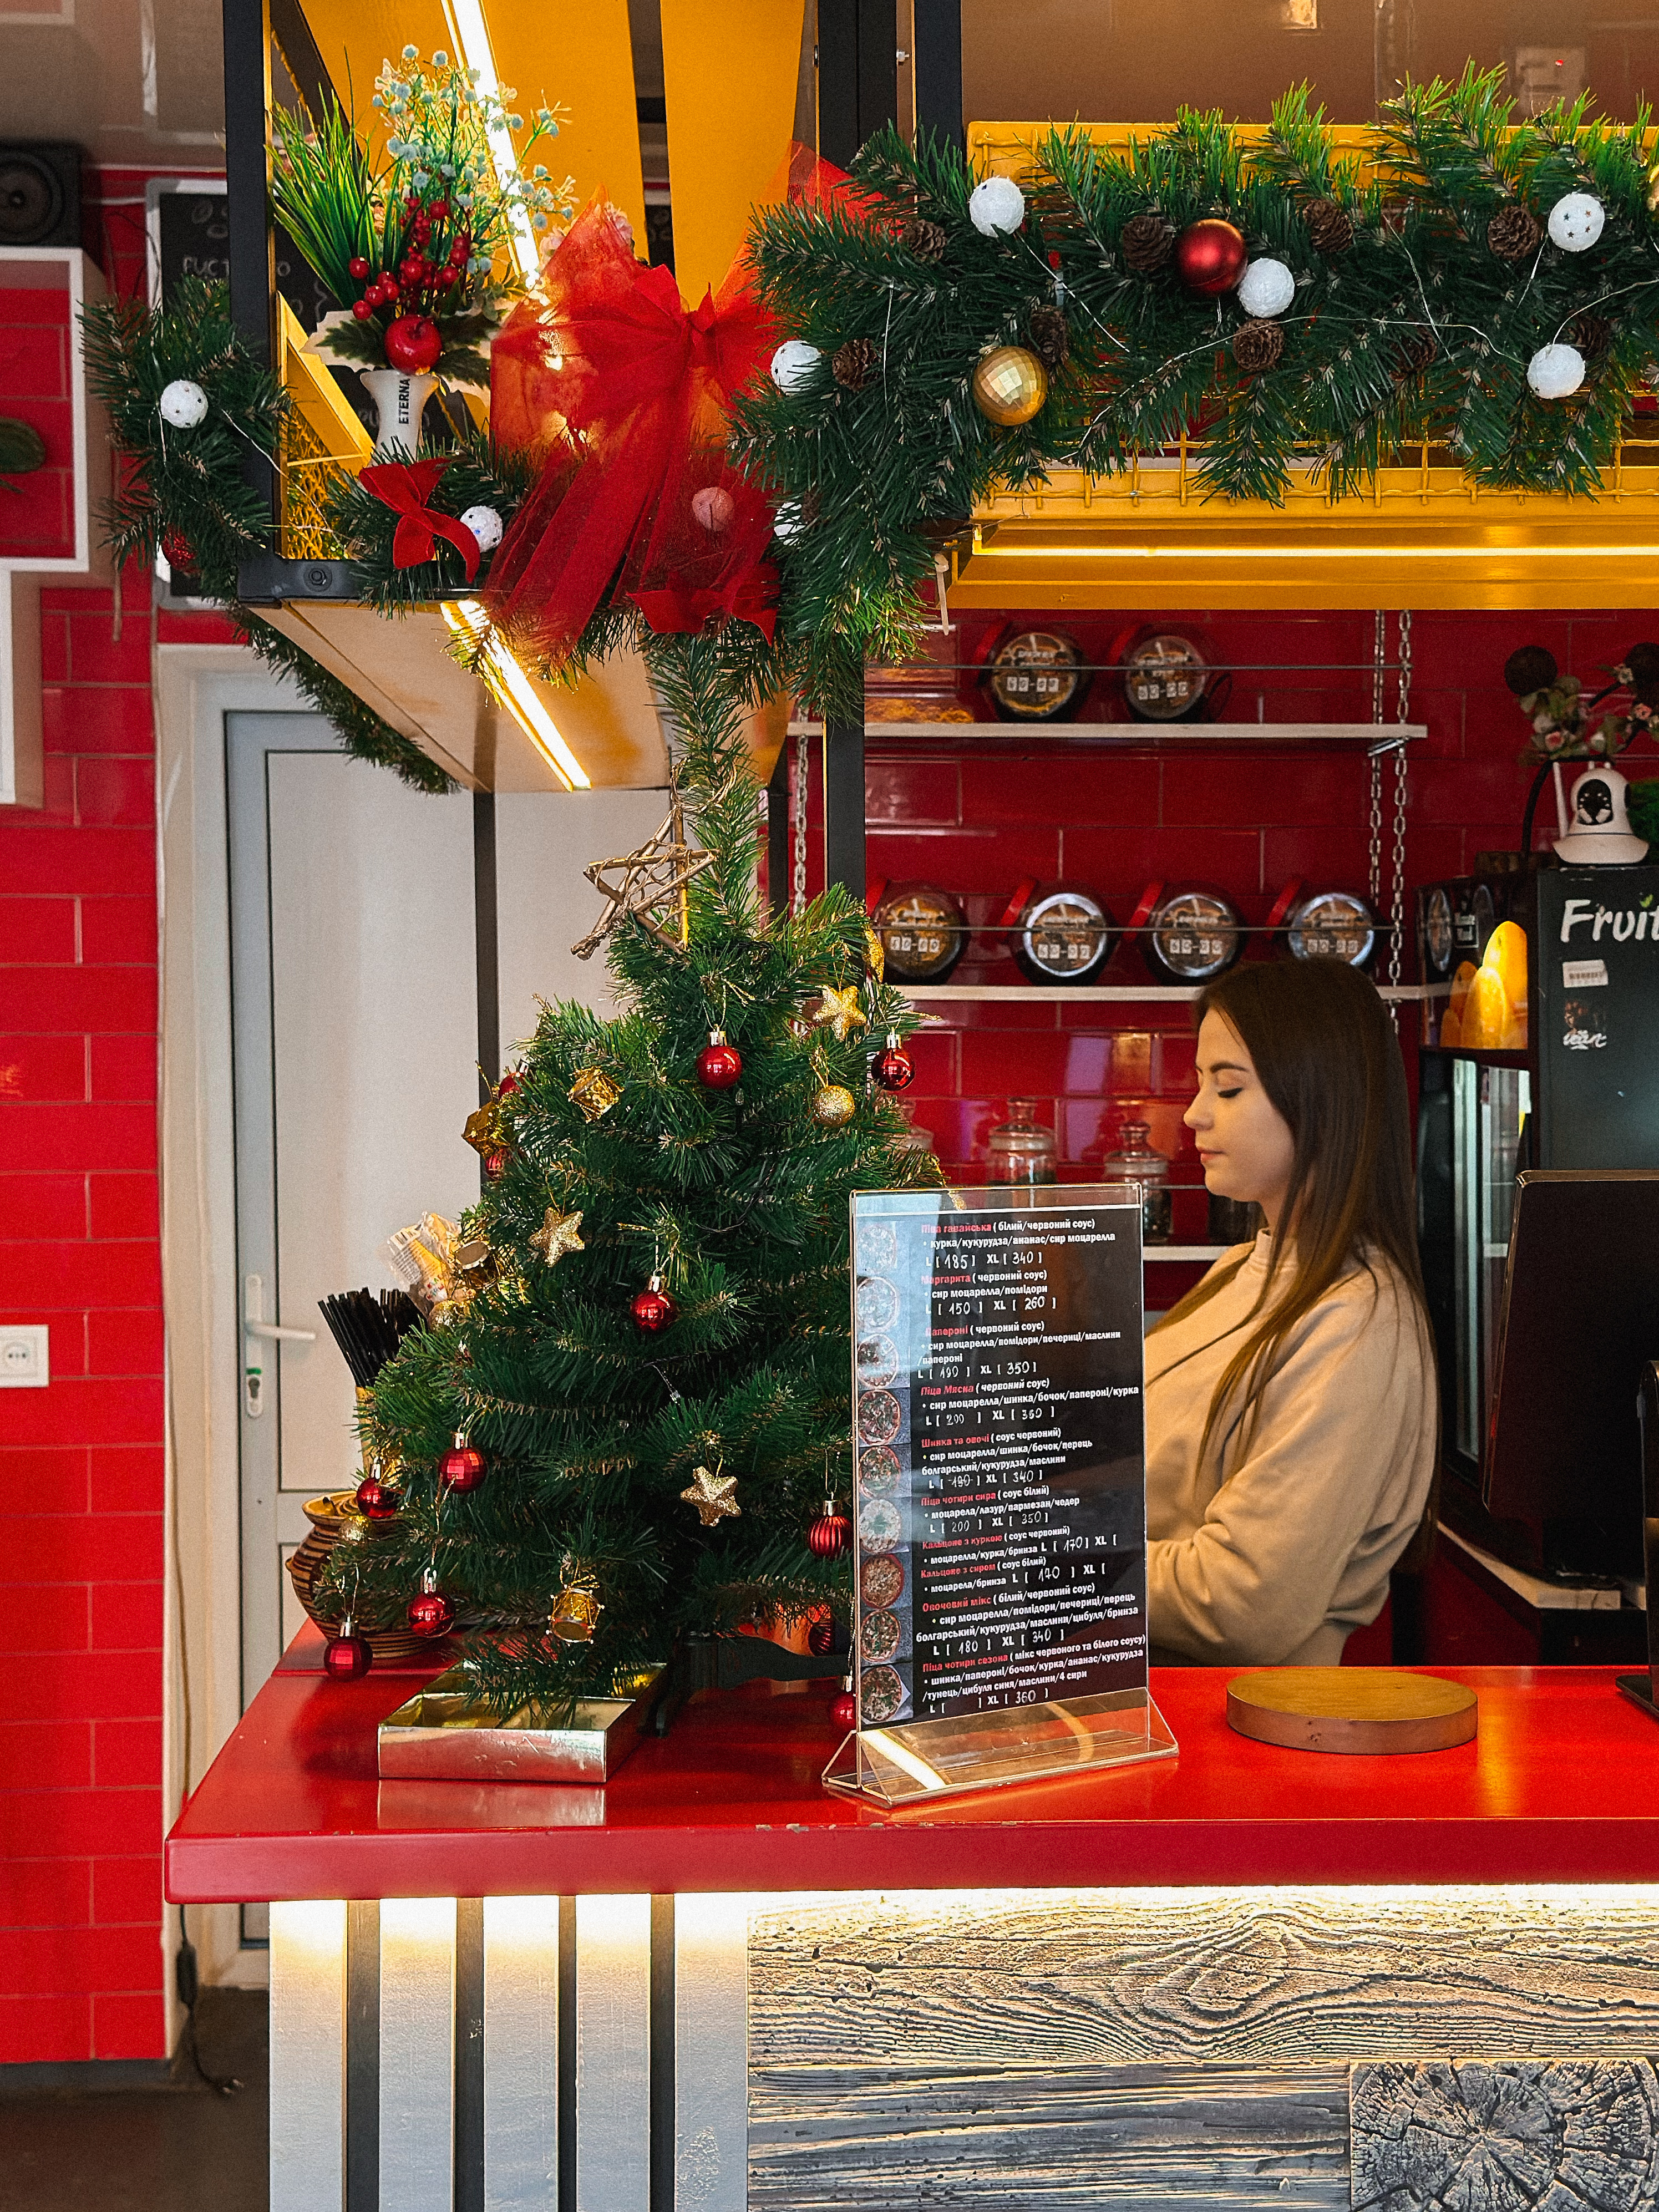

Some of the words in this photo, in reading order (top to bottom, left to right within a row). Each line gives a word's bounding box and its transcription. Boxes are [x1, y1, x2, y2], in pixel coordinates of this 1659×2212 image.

[399, 378, 410, 424] ETERNA
[1072, 1219, 1095, 1229] соус)
[1068, 1233, 1115, 1243] моцарелла
[926, 1257, 931, 1266] L
[945, 1254, 968, 1269] 185
[987, 1254, 999, 1264] XL
[1012, 1251, 1033, 1264] 340
[1024, 1270, 1047, 1281] соус)
[932, 1291, 948, 1300] сир
[951, 1285, 1047, 1297] моцарелла/помідори
[926, 1304, 931, 1314] L
[949, 1302, 970, 1315] 150
[993, 1301, 1006, 1310] XL
[1024, 1296, 1046, 1310] 260
[1021, 1321, 1044, 1332] соус)
[918, 1370, 924, 1378] L
[981, 1365, 992, 1374] XL
[1007, 1361, 1029, 1374] 350
[921, 1387, 941, 1396] Піца
[944, 1385, 974, 1394] Мясна
[1027, 1378, 1049, 1389] соус)
[930, 1402, 946, 1411] сир
[926, 1416, 932, 1425] L
[946, 1414, 965, 1425] 200
[992, 1410, 1004, 1420] XL
[921, 1439, 952, 1448] Шинка
[966, 1434, 990, 1444] овочі
[1017, 1427, 1061, 1440] червоний)
[930, 1453, 946, 1462] сир
[929, 1480, 934, 1489] L
[986, 1474, 997, 1483] XL
[1013, 1470, 1033, 1483] 340
[921, 1497, 940, 1506] Піца
[943, 1495, 973, 1504] чотири
[976, 1493, 996, 1502] сира
[1024, 1485, 1049, 1496] білий)
[930, 1525, 935, 1533] L
[952, 1520, 970, 1532] 200
[992, 1518, 1003, 1526] XL
[1022, 1511, 1041, 1524] 350
[922, 1538, 962, 1549] Кальцоне
[971, 1535, 1002, 1545] куркою
[1028, 1526, 1070, 1539] червоний)
[1042, 1543, 1047, 1551] L
[1064, 1536, 1082, 1552] 170
[1095, 1536, 1107, 1545] XL
[921, 1568, 960, 1578] Кальцоне
[970, 1564, 995, 1573] сиром
[1022, 1556, 1046, 1566] білий)
[931, 1577, 1006, 1592] моцарела/бринза
[1012, 1574, 1018, 1583] L
[1083, 1564, 1095, 1575] XL
[922, 1597, 968, 1612] Овочевий
[971, 1597, 991, 1606] мікс
[1073, 1582, 1095, 1594] соус)
[940, 1617, 956, 1625] сир
[933, 1646, 940, 1655] L
[958, 1640, 978, 1654] 180
[1002, 1636, 1014, 1646] XL
[1032, 1628, 1051, 1643] 340
[923, 1663, 942, 1672] Піца
[945, 1660, 975, 1668] чотири
[978, 1655, 1008, 1664] сезона
[1036, 1645, 1080, 1656] червоного
[1093, 1640, 1118, 1649] білого
[1120, 1635, 1145, 1645] соусу)
[1067, 1671, 1087, 1680] сири
[930, 1704, 935, 1713] L
[987, 1696, 999, 1704] XL
[1015, 1690, 1036, 1703] 360
